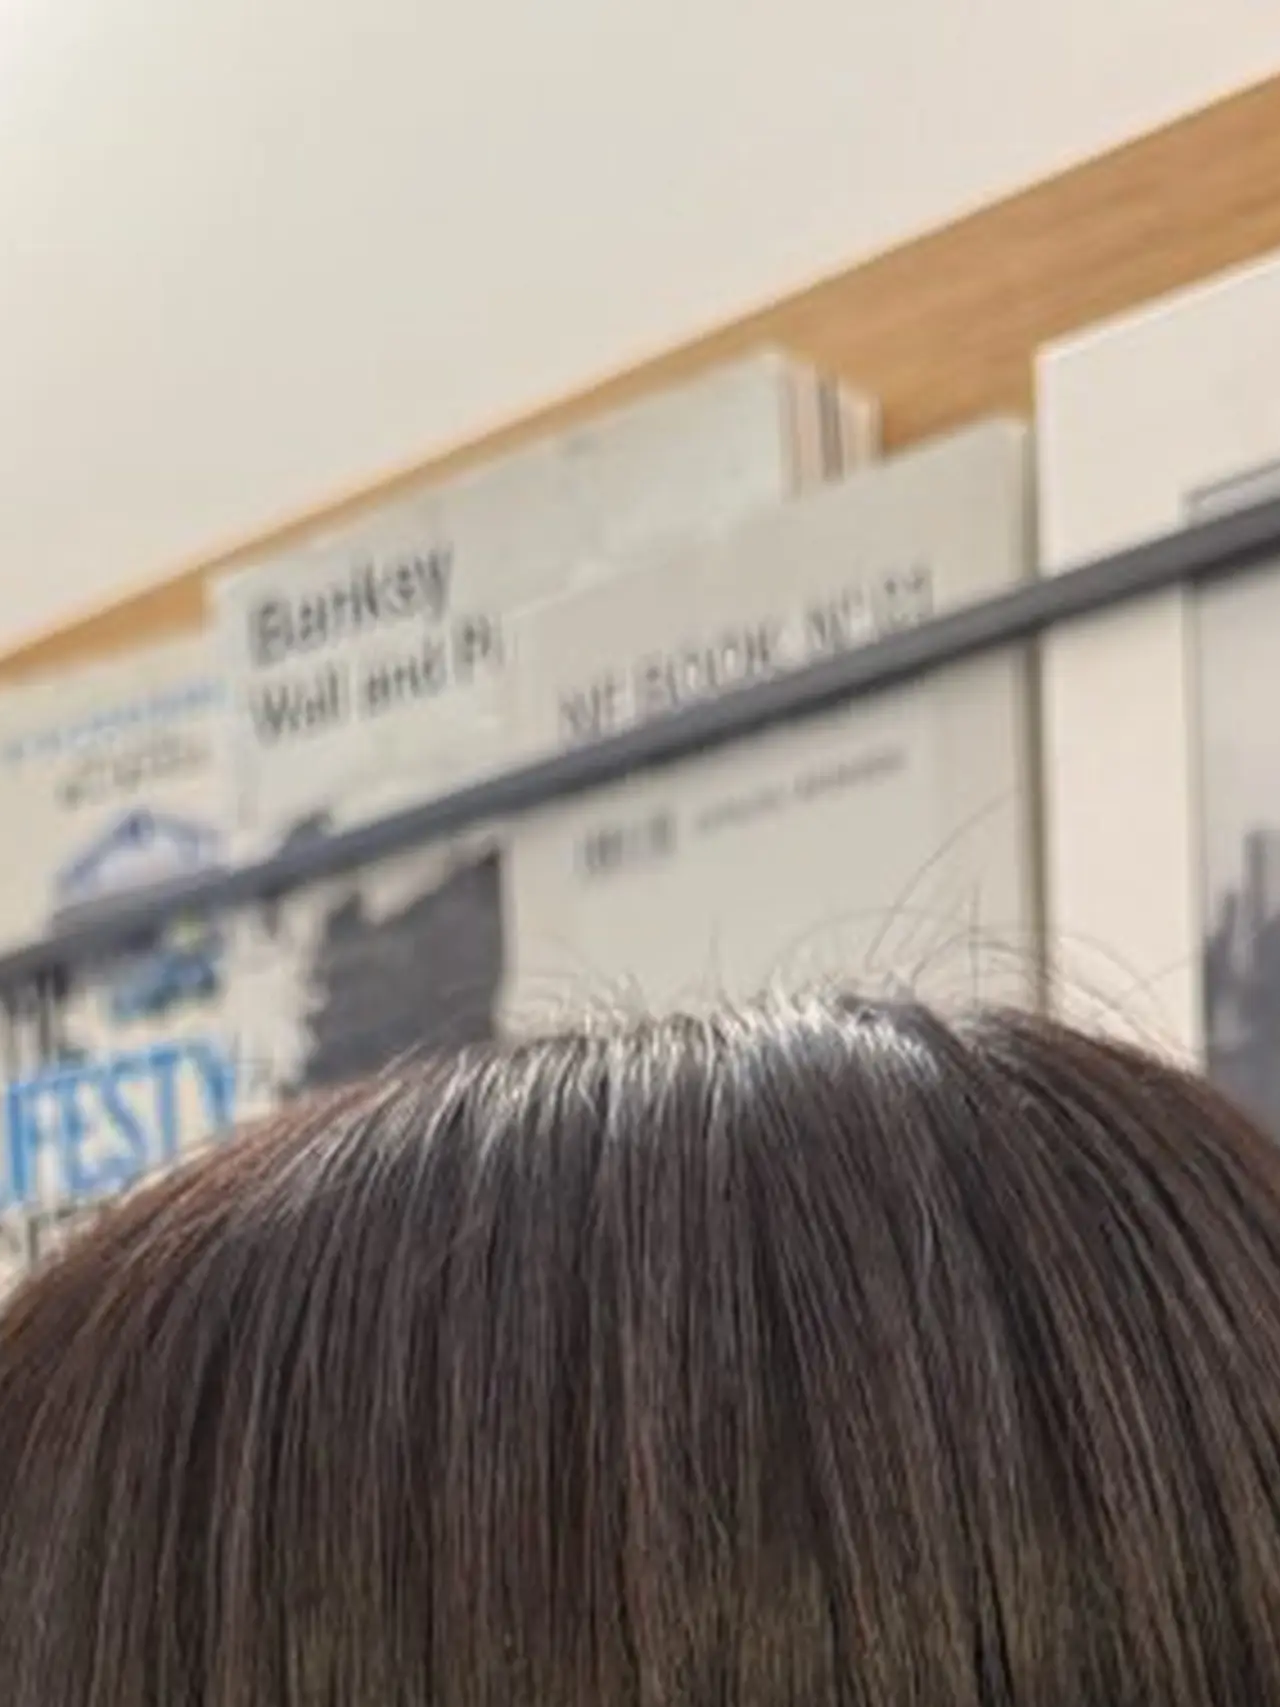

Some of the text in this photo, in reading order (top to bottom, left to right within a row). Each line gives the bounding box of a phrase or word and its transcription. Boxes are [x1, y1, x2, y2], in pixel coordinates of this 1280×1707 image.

[247, 541, 454, 668] Banksy
[250, 662, 345, 747] Wall
[362, 636, 448, 718] and
